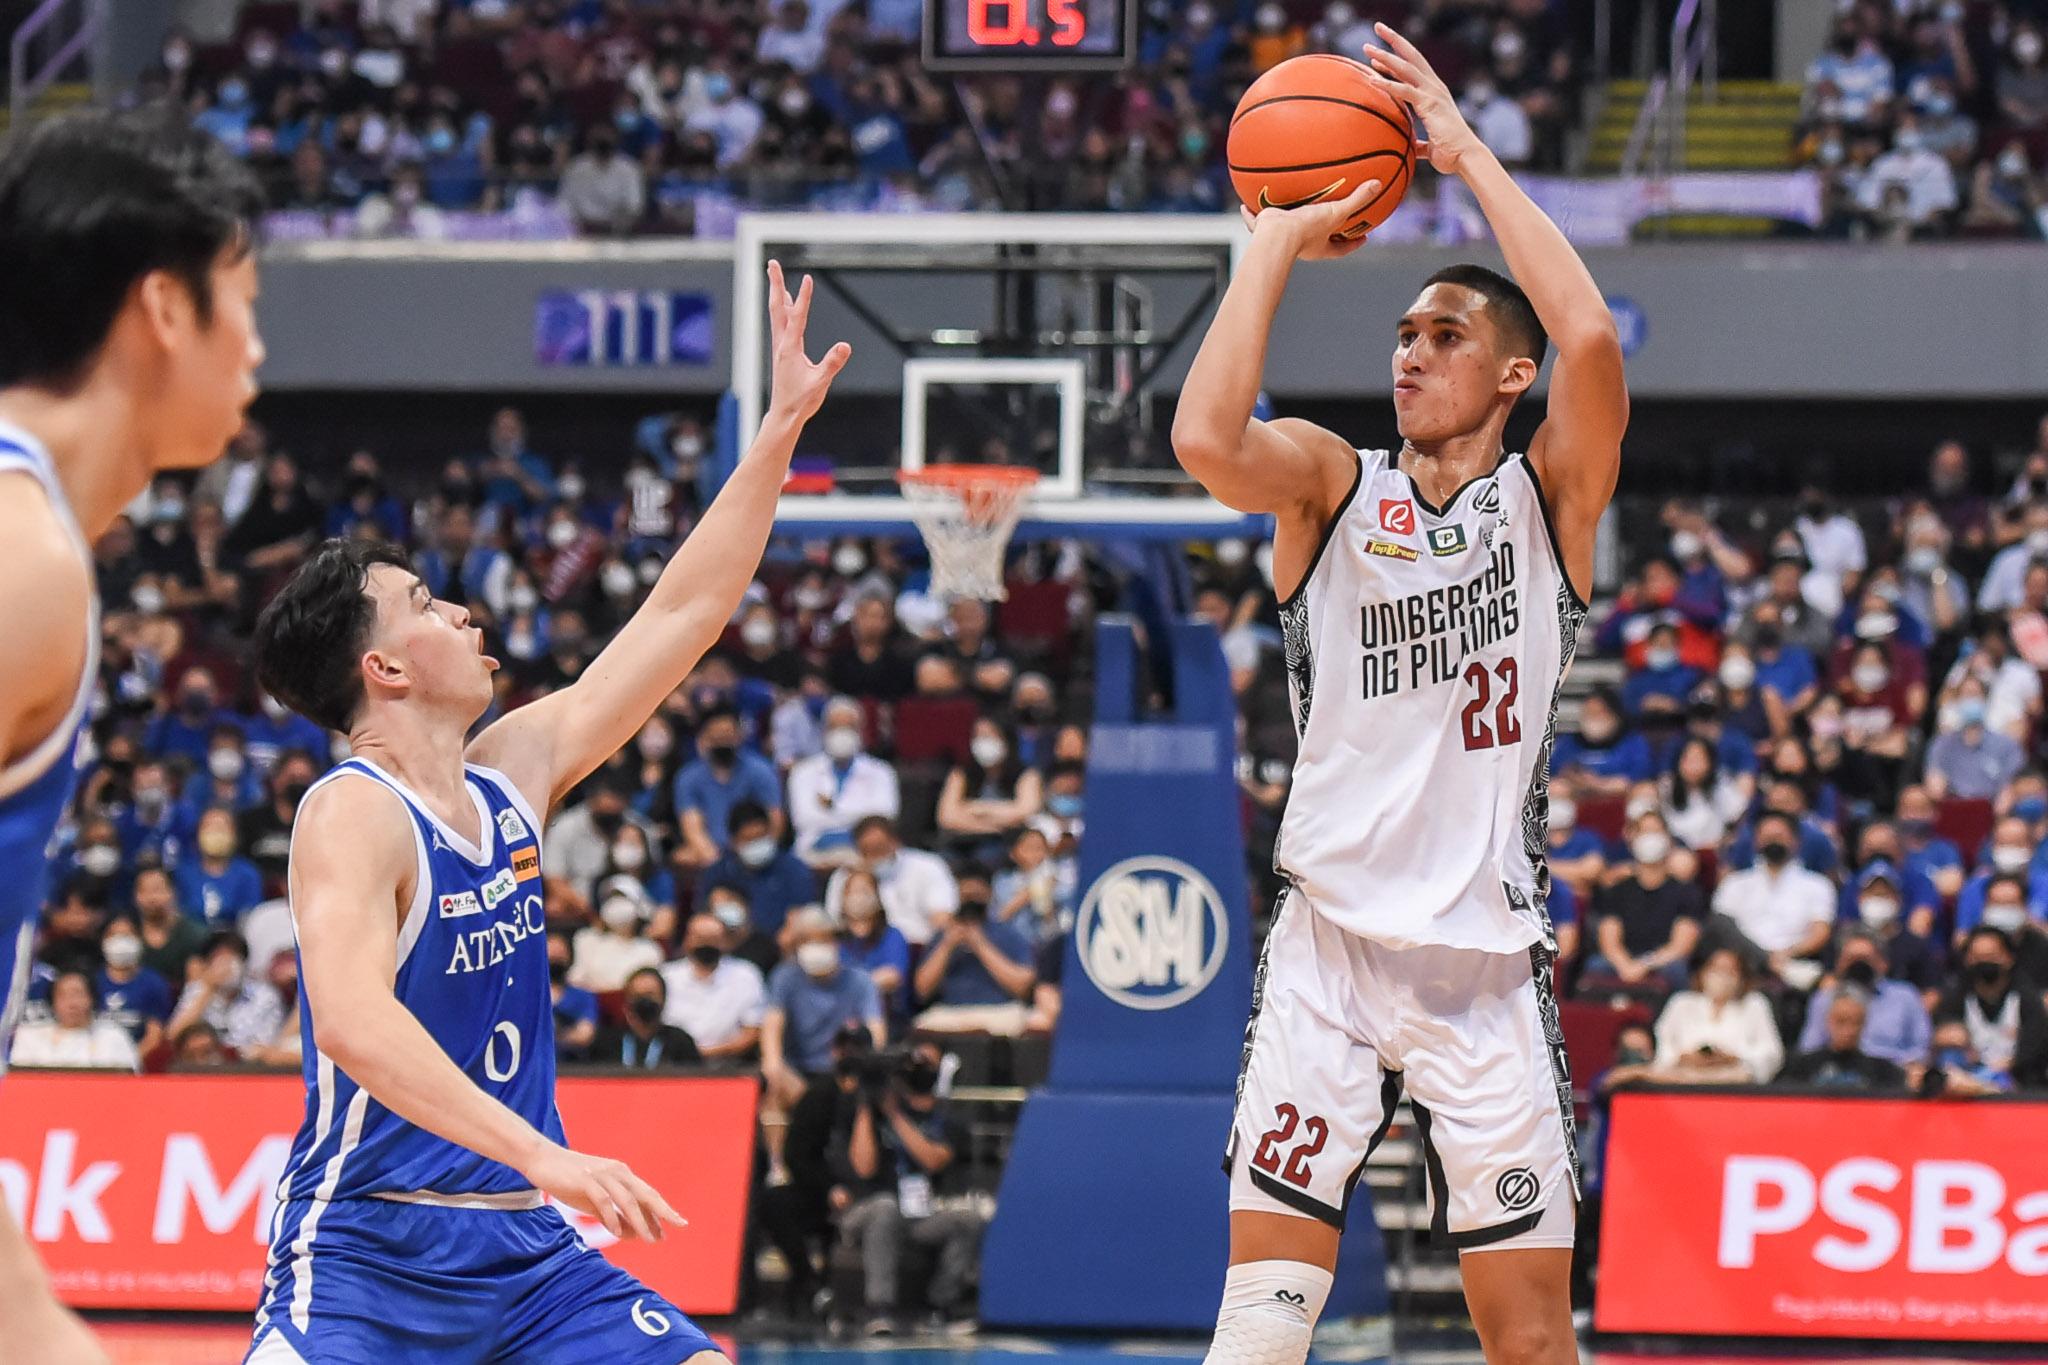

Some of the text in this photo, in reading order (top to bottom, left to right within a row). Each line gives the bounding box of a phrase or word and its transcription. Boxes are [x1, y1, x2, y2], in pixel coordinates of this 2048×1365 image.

[575, 289, 670, 367] 111
[1369, 541, 1419, 560] TopBreed
[1362, 648, 1399, 700] NG
[1461, 656, 1521, 751] 22
[1088, 876, 1204, 990] SM
[1252, 1102, 1329, 1189] 22
[1717, 1154, 2048, 1277] PSBa
[631, 1298, 671, 1337] 6
